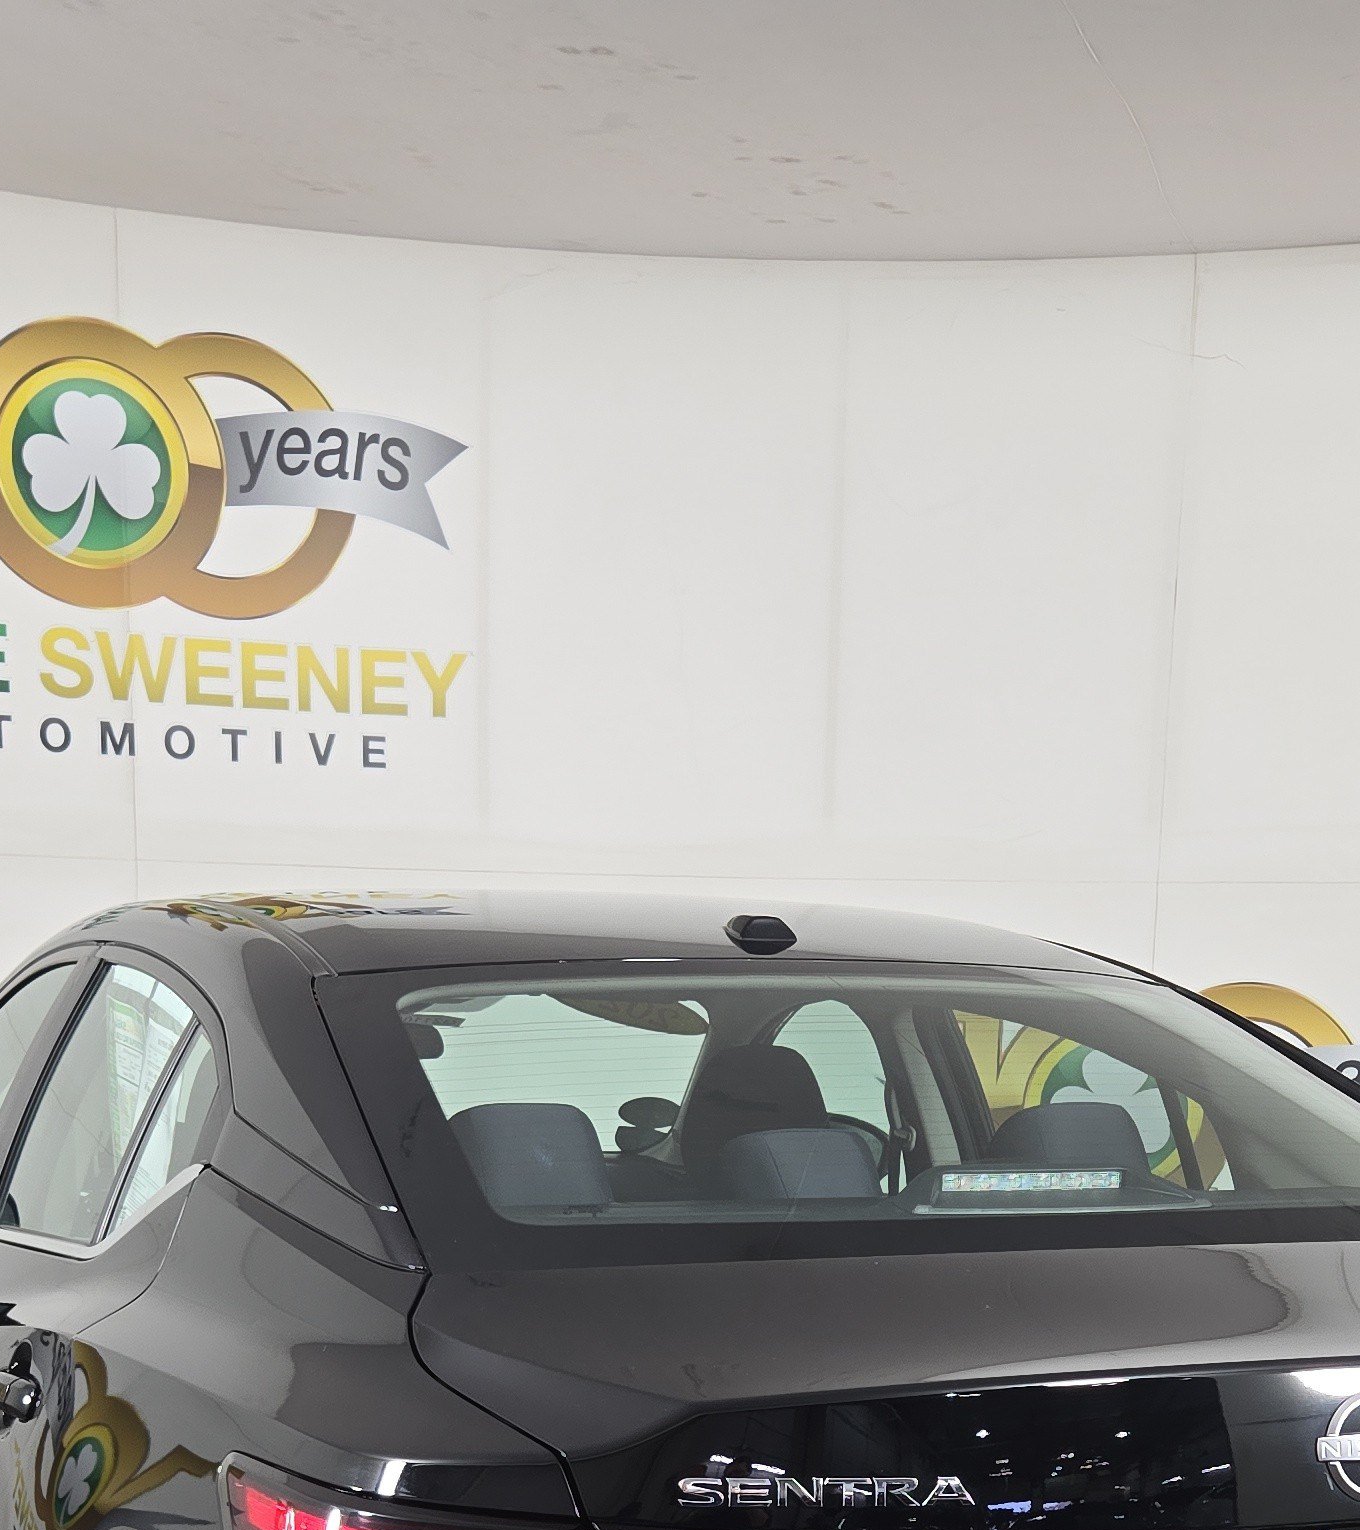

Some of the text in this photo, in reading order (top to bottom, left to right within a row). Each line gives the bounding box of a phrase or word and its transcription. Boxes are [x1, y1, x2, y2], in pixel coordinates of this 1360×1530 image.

[238, 426, 413, 493] years
[40, 626, 468, 718] SWEENEY
[677, 1476, 976, 1507] SENTRA
